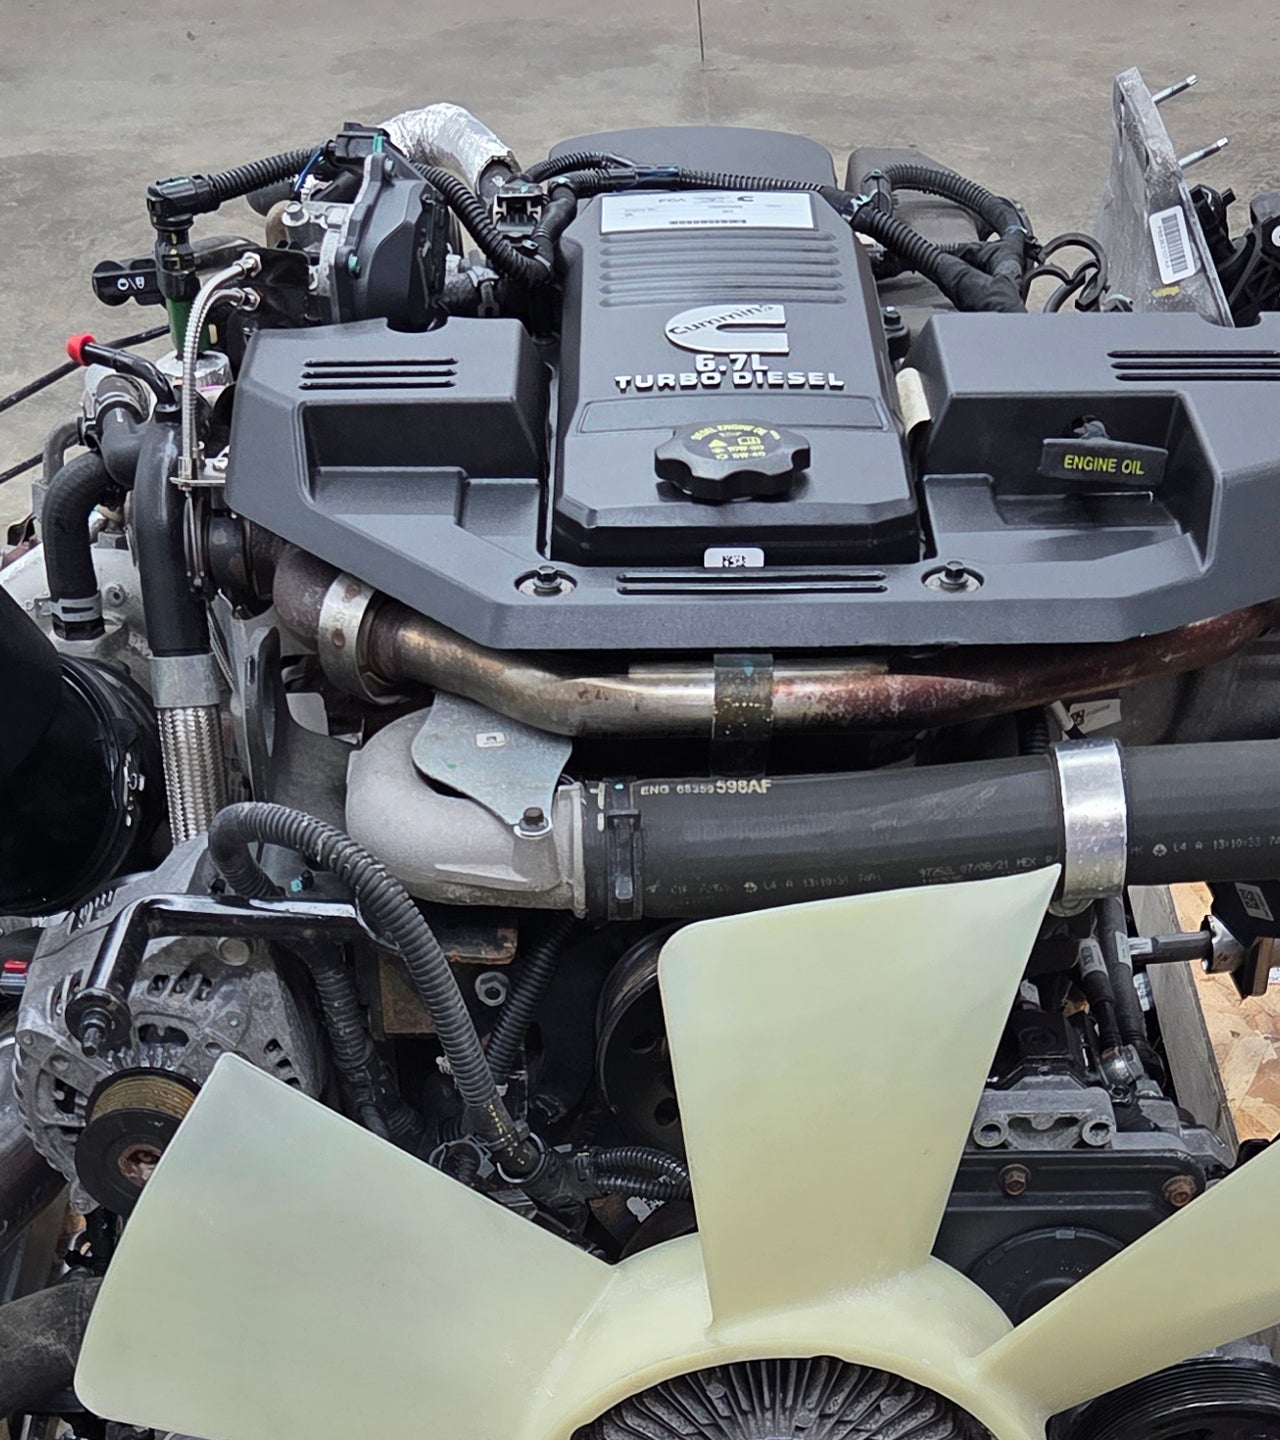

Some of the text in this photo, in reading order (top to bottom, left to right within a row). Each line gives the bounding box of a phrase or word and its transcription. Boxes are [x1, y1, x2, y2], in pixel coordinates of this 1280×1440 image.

[668, 304, 773, 335] Cummins
[695, 354, 770, 374] 6.7L
[614, 371, 846, 393] TURBO DIESEL
[1064, 454, 1145, 475] ENGINE OIL
[640, 784, 670, 796] ENG
